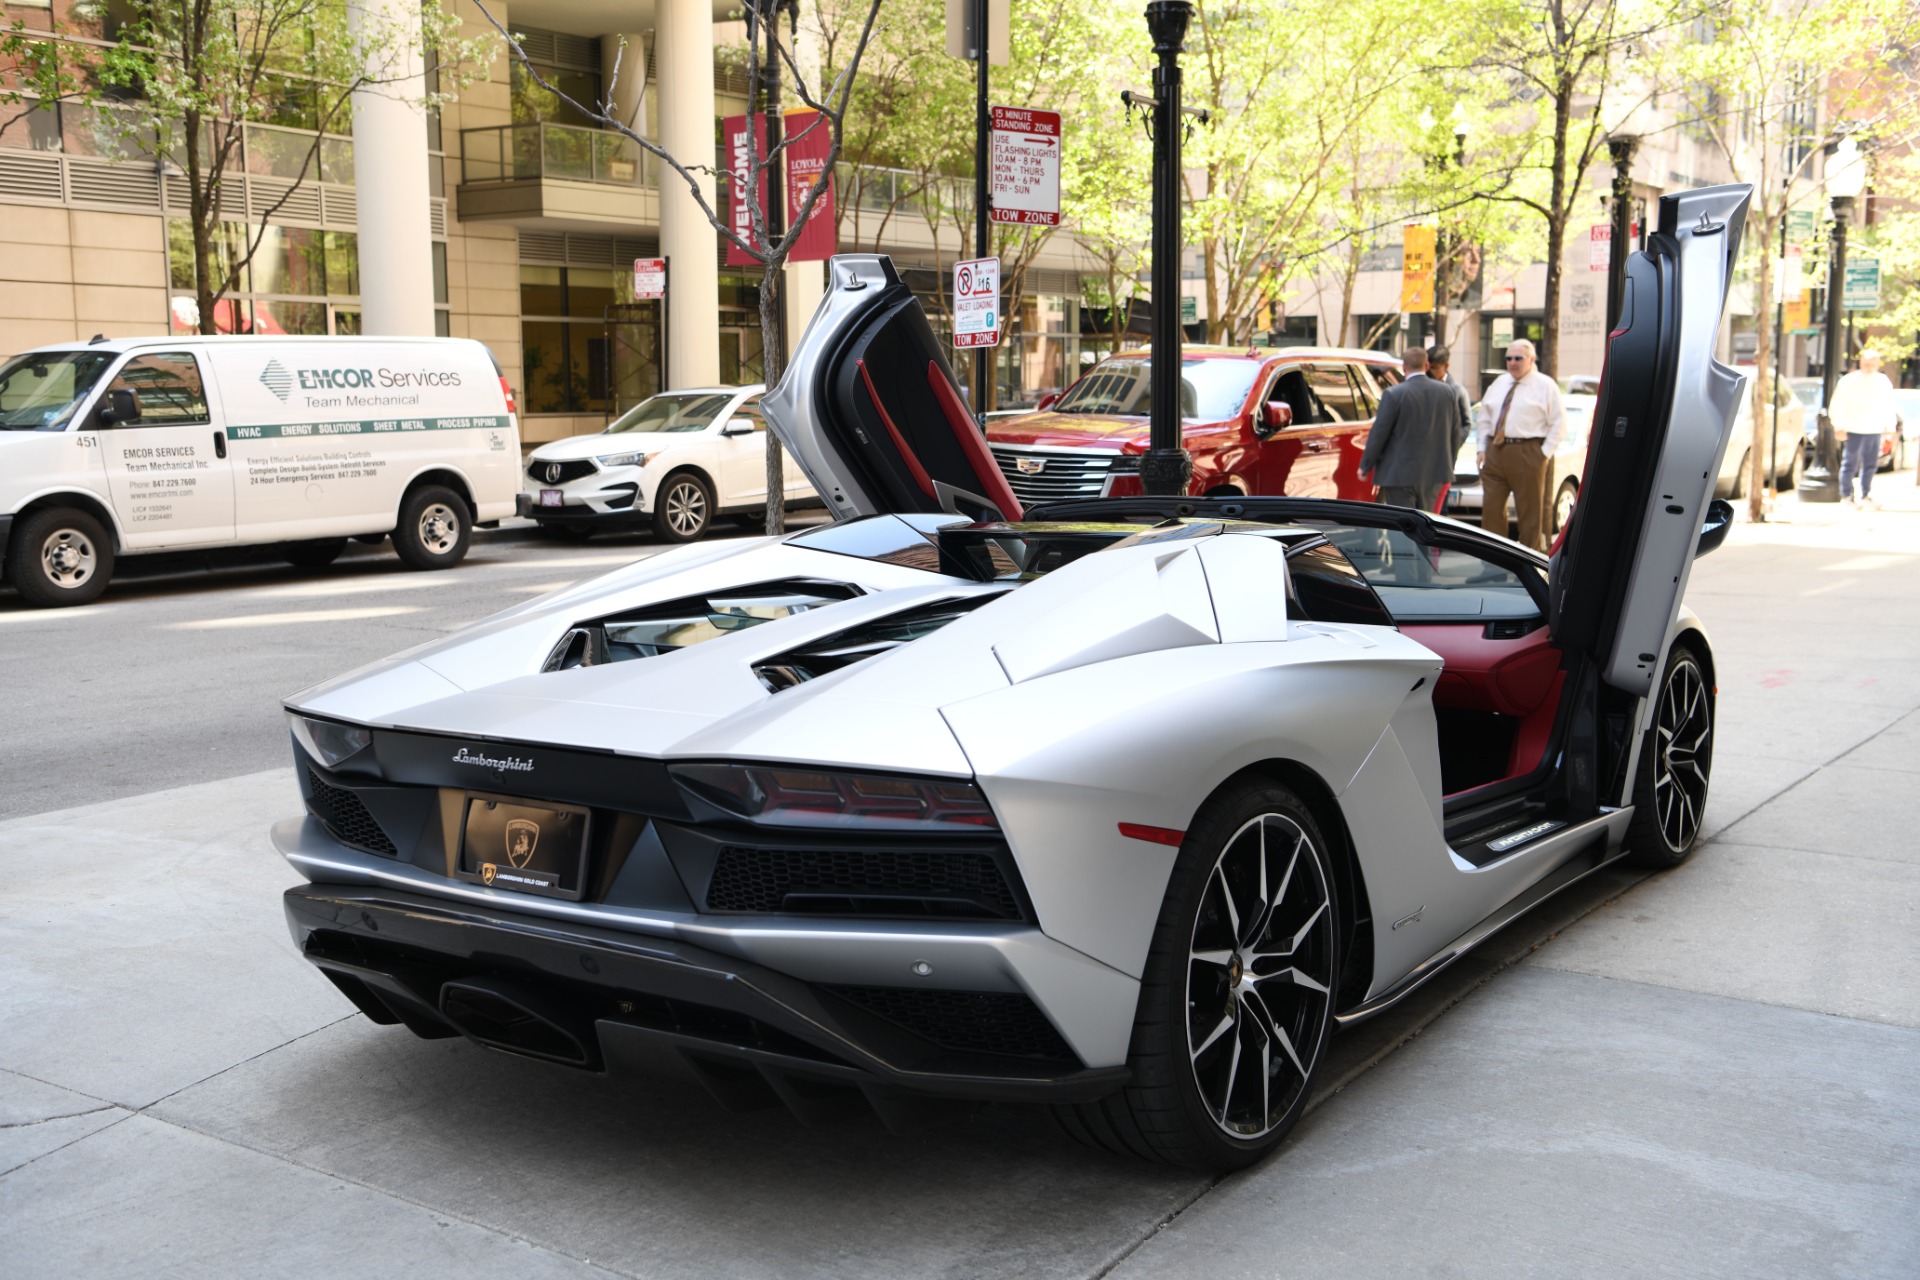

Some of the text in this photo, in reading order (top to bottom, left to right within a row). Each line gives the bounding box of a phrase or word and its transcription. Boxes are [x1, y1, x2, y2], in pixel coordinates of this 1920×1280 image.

[996, 109, 1032, 121] 15 MINUTE
[996, 119, 1054, 133] STANDING ZONE
[995, 135, 1009, 144] USE
[995, 145, 1057, 158] FLASHING LIGHTS
[791, 158, 825, 170] LOYOLA
[1024, 157, 1028, 165] 8
[1031, 158, 1041, 166] PM
[995, 164, 1011, 173] MON
[1020, 166, 1044, 176] THURS
[995, 174, 1002, 182] 10
[1030, 177, 1040, 185] PM
[734, 132, 750, 250] WELCOME
[995, 183, 1007, 192] FRI
[1015, 186, 1030, 194] SUN
[995, 209, 1054, 224] TOW ZONE
[957, 301, 993, 311] VALET LOADING
[956, 333, 994, 346] TOW ZONE
[297, 368, 461, 389] EMCOR Services
[305, 394, 419, 408] Team Mechanical
[281, 423, 361, 435] ENERGY SOLUTIONS
[374, 420, 426, 431] SHEET METAL
[437, 418, 496, 428] PROCESS PIPING
[237, 427, 261, 438] HVAC
[76, 436, 97, 448] 451
[123, 447, 195, 459] EMCOR SERVICES
[126, 460, 211, 472] Team Mechanical Inc.
[250, 467, 278, 476] Complete
[280, 465, 300, 473] Design
[276, 474, 309, 483] Emergency
[338, 469, 377, 478] 847.229.7600
[152, 478, 196, 487] 847.229.7600
[452, 748, 534, 771] Lamborghini
[496, 873, 524, 882] LAMBORGHINI
[535, 879, 549, 887] COAST
